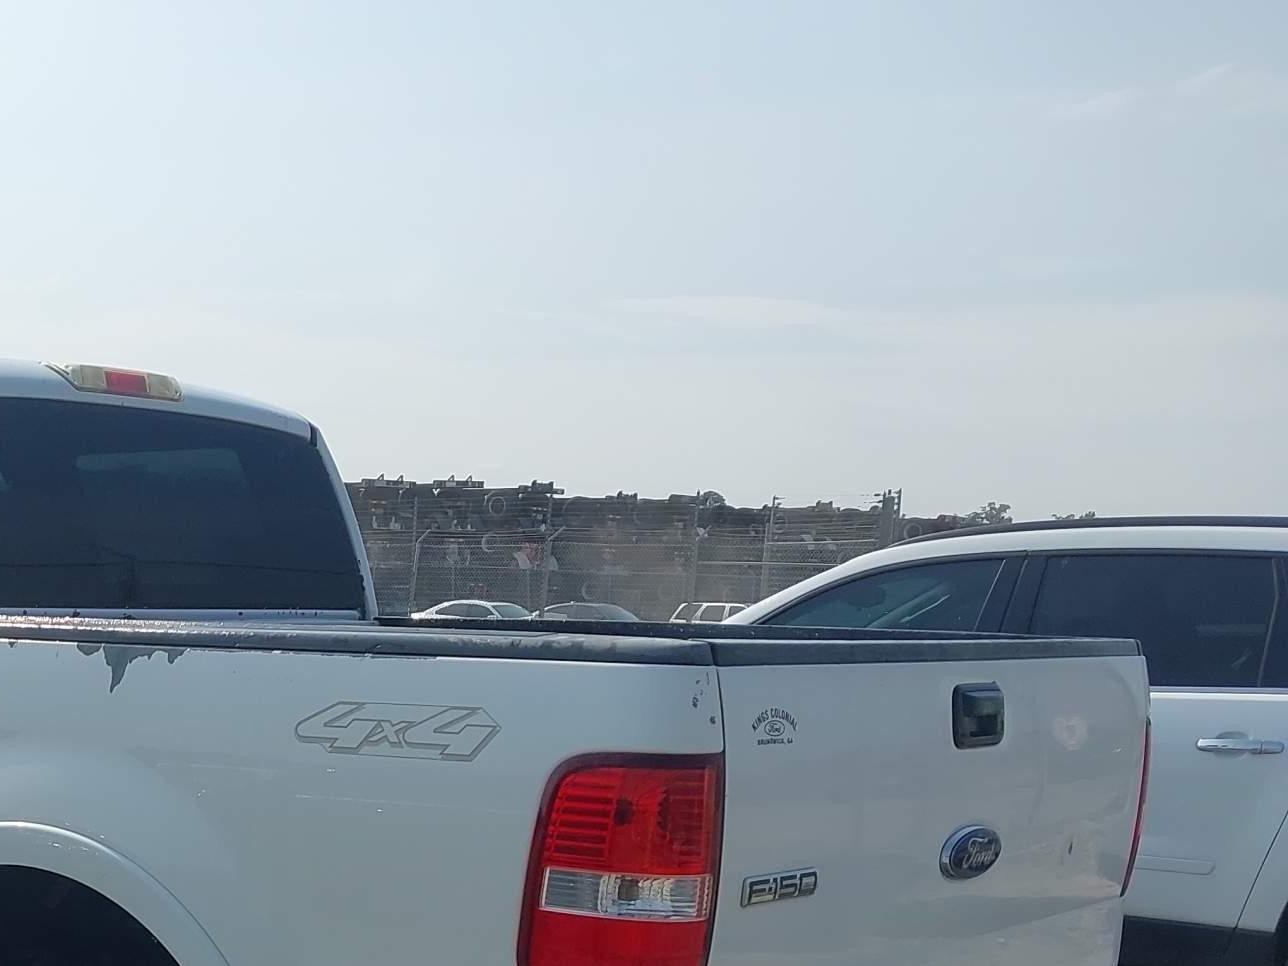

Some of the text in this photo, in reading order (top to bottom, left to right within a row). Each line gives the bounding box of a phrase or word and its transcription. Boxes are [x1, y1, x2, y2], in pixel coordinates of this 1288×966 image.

[294, 700, 502, 762] 4x4
[752, 709, 770, 732] KINGS
[963, 836, 999, 871] Ford
